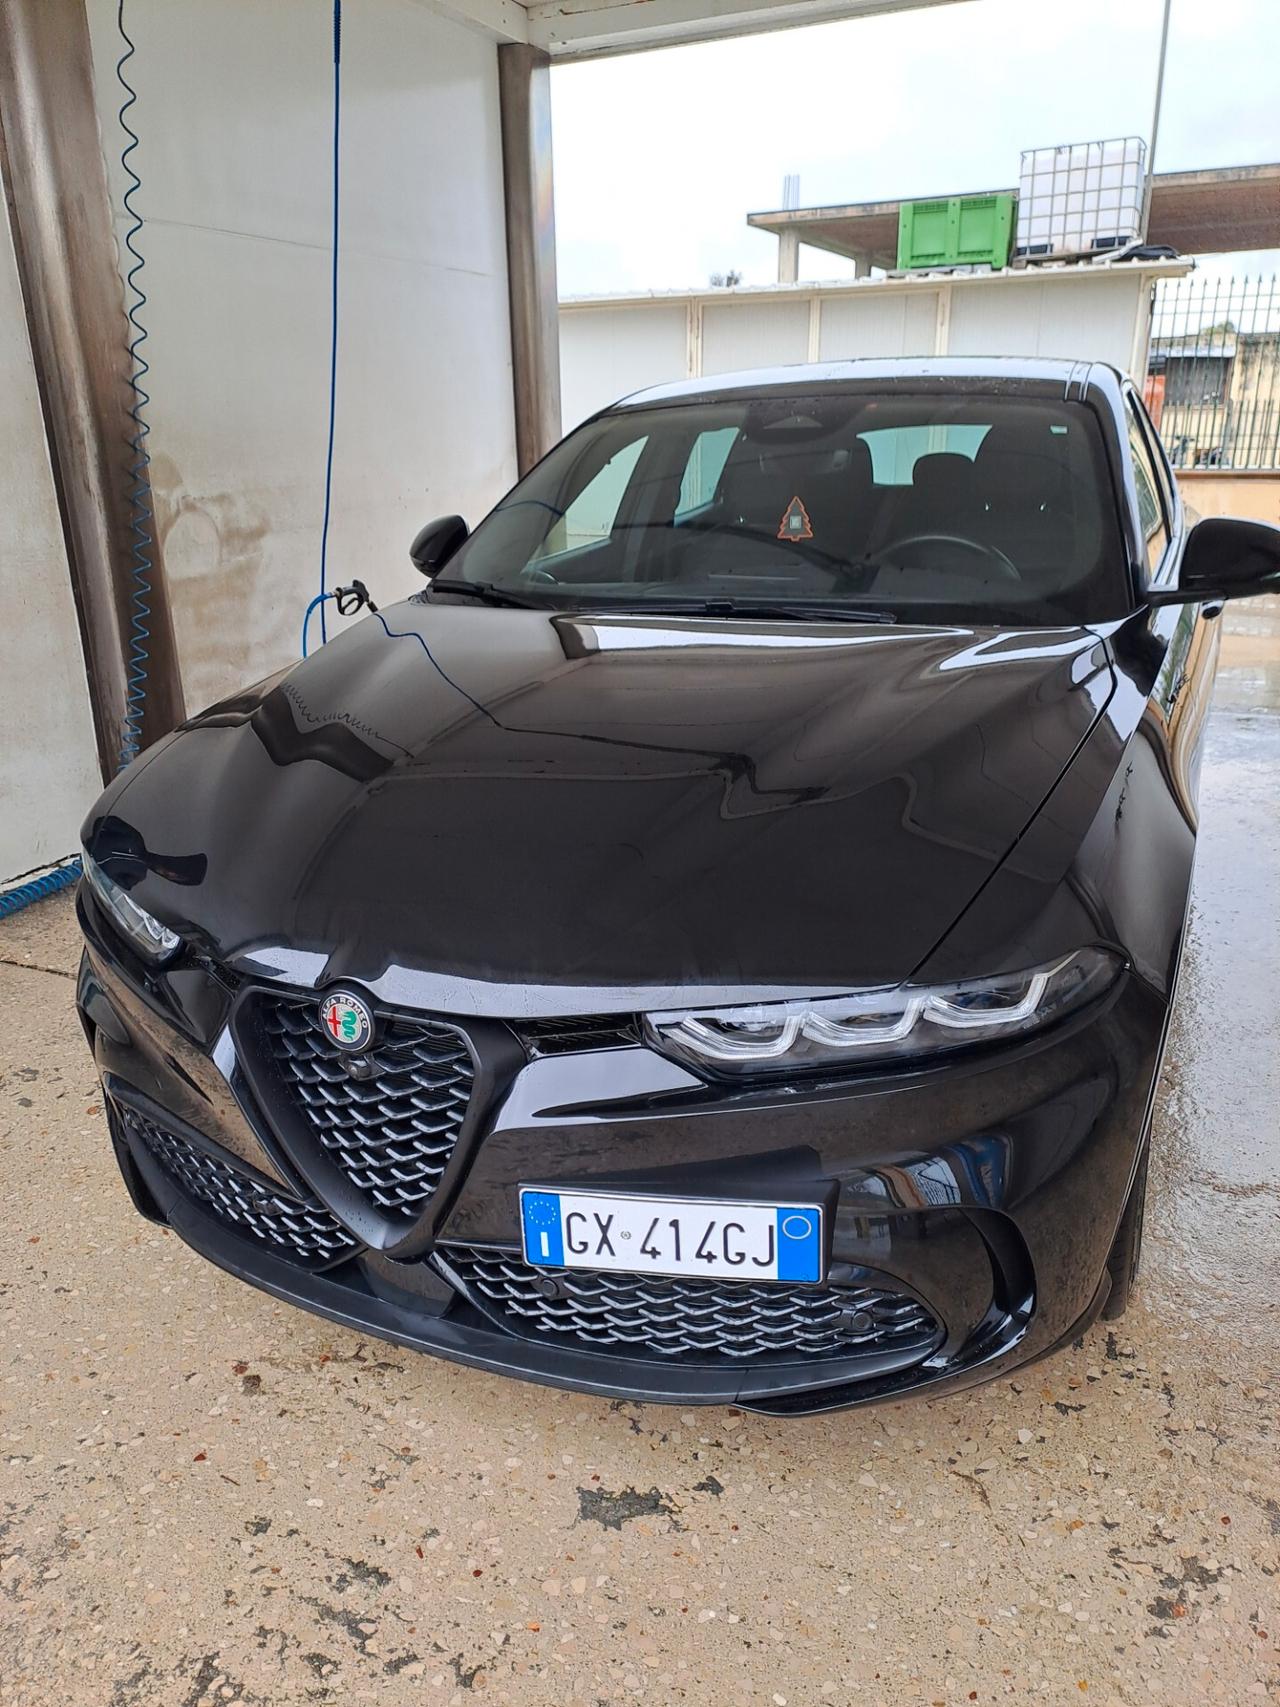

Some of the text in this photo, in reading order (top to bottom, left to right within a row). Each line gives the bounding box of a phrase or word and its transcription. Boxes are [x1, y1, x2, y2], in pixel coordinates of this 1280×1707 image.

[322, 997, 368, 1029] ALFA ROMEO
[565, 1212, 775, 1268] GX 414GJ
